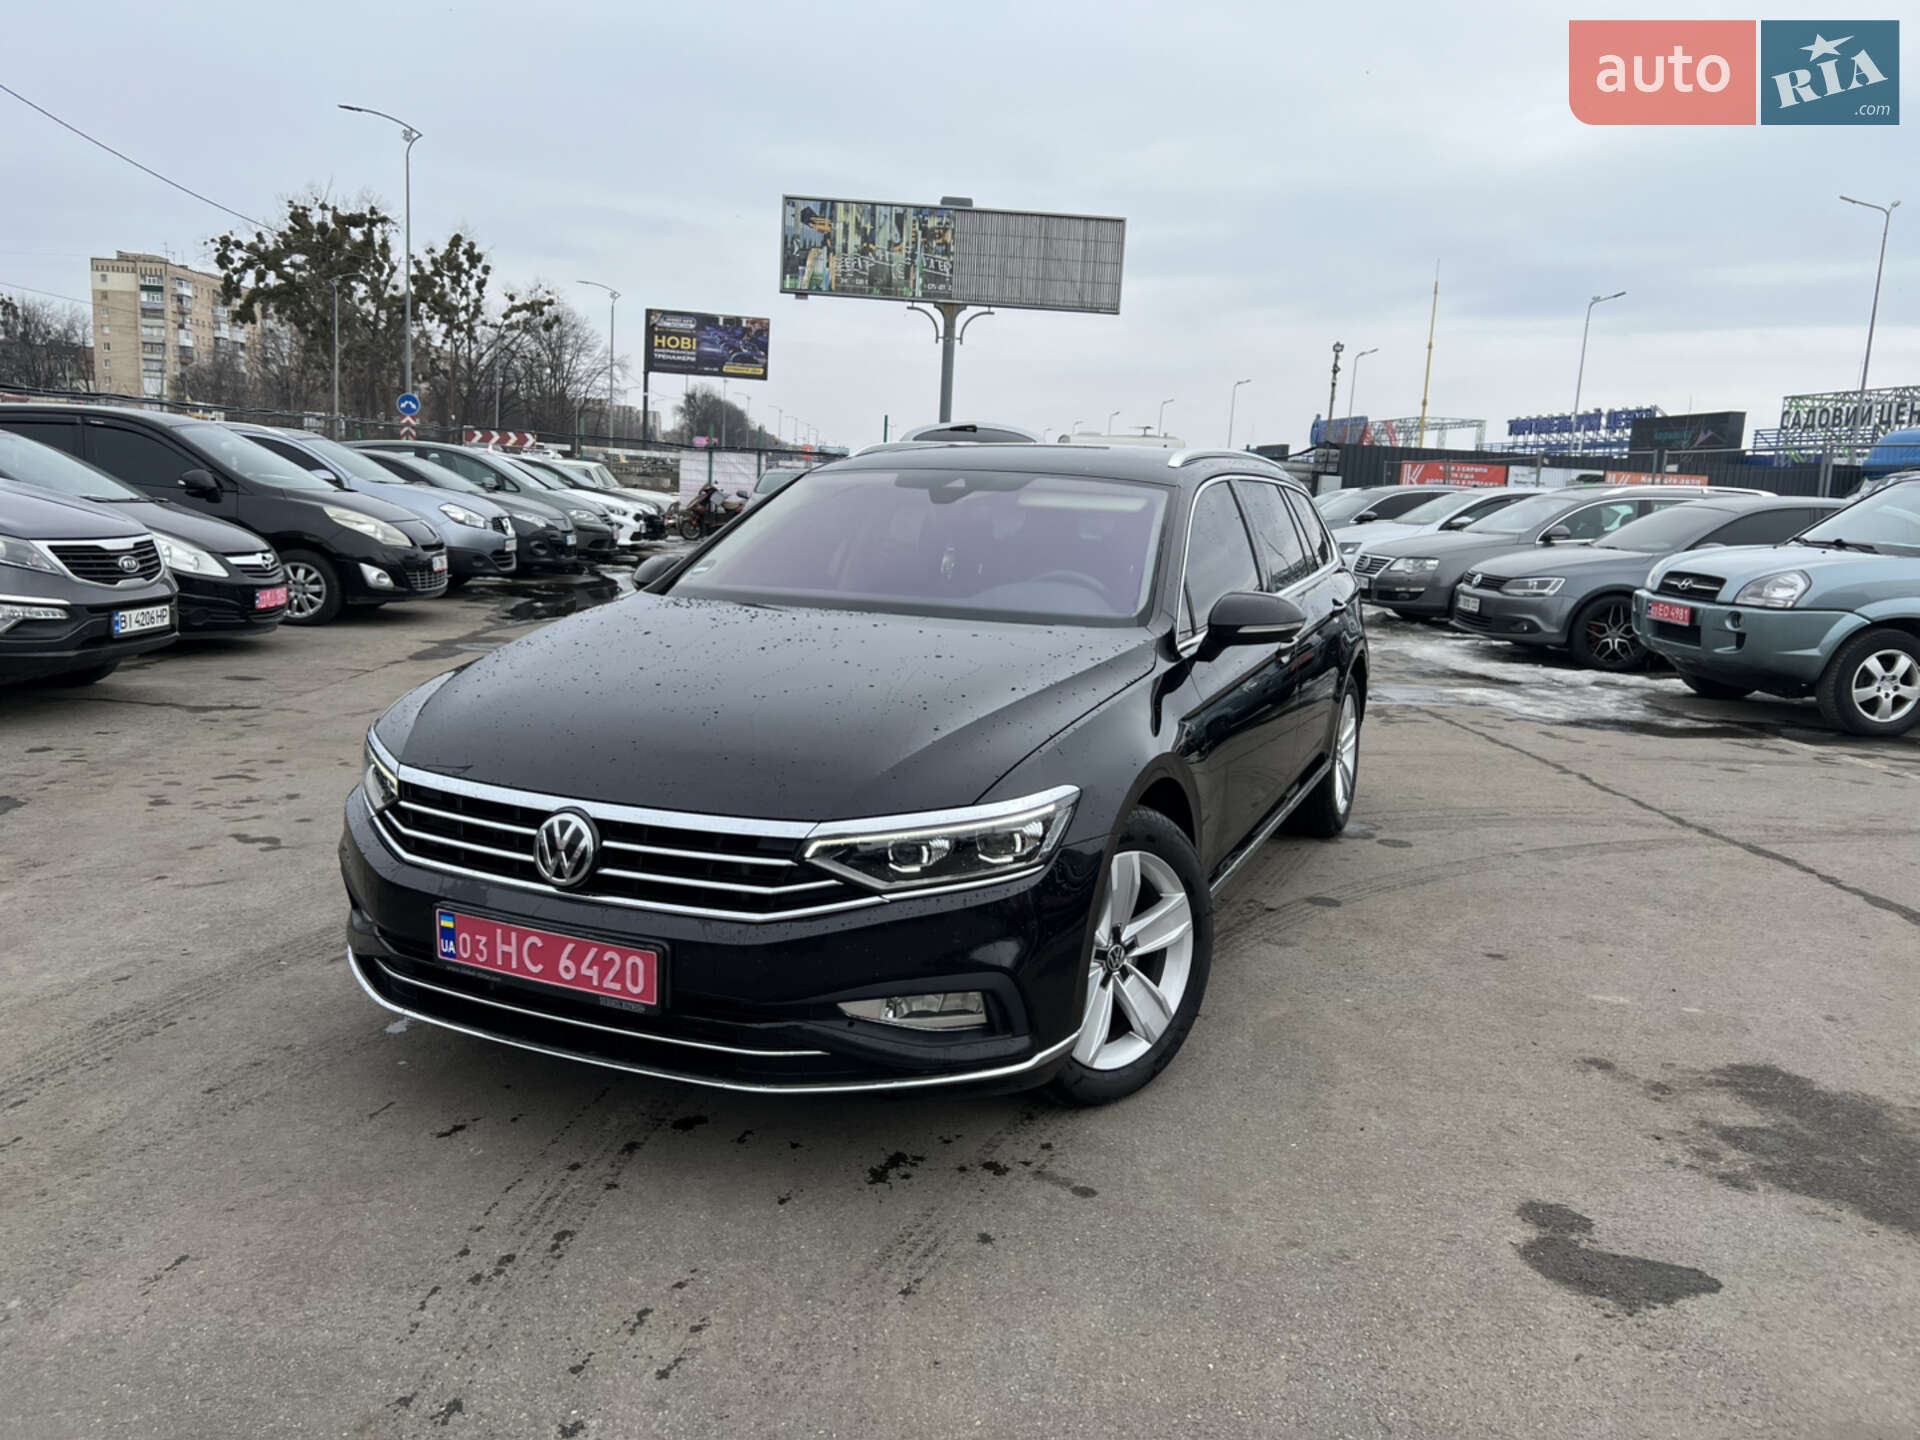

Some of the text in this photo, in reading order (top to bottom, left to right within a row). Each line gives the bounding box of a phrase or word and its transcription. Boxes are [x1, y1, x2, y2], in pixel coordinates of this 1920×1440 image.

[654, 335, 697, 350] НОВІ
[1780, 399, 1873, 432] САДОВИЙ
[135, 609, 156, 628] 4206
[156, 606, 168, 622] HP
[441, 939, 456, 954] UA
[458, 929, 645, 995] 03 HC 6420
